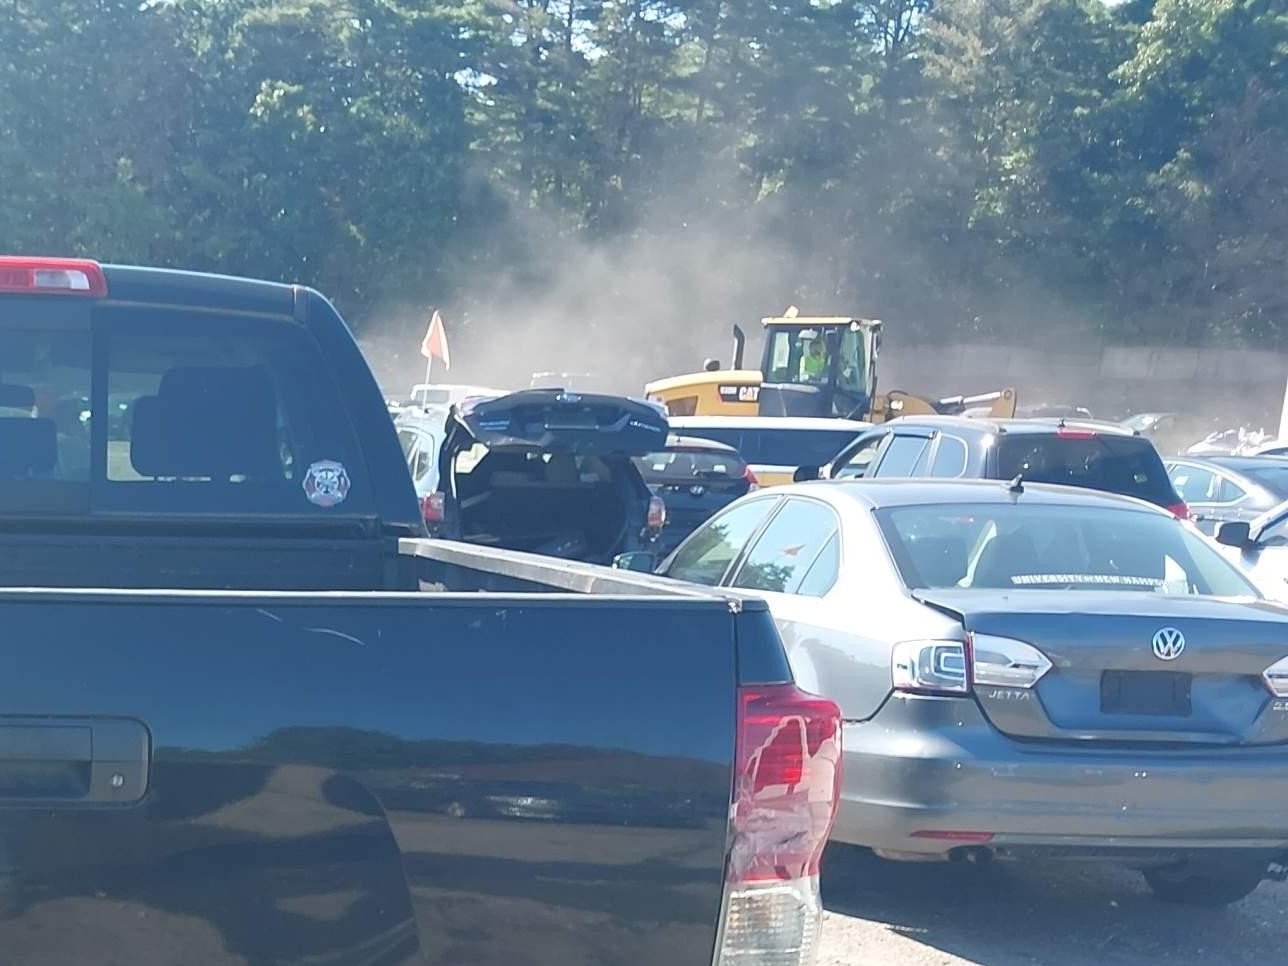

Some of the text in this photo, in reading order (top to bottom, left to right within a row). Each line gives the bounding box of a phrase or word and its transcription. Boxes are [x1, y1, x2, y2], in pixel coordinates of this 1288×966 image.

[739, 386, 760, 401] CAT
[1011, 575, 1082, 585] UNIVERSITY
[1094, 575, 1120, 584] NEW
[988, 690, 1030, 700] JETTA
